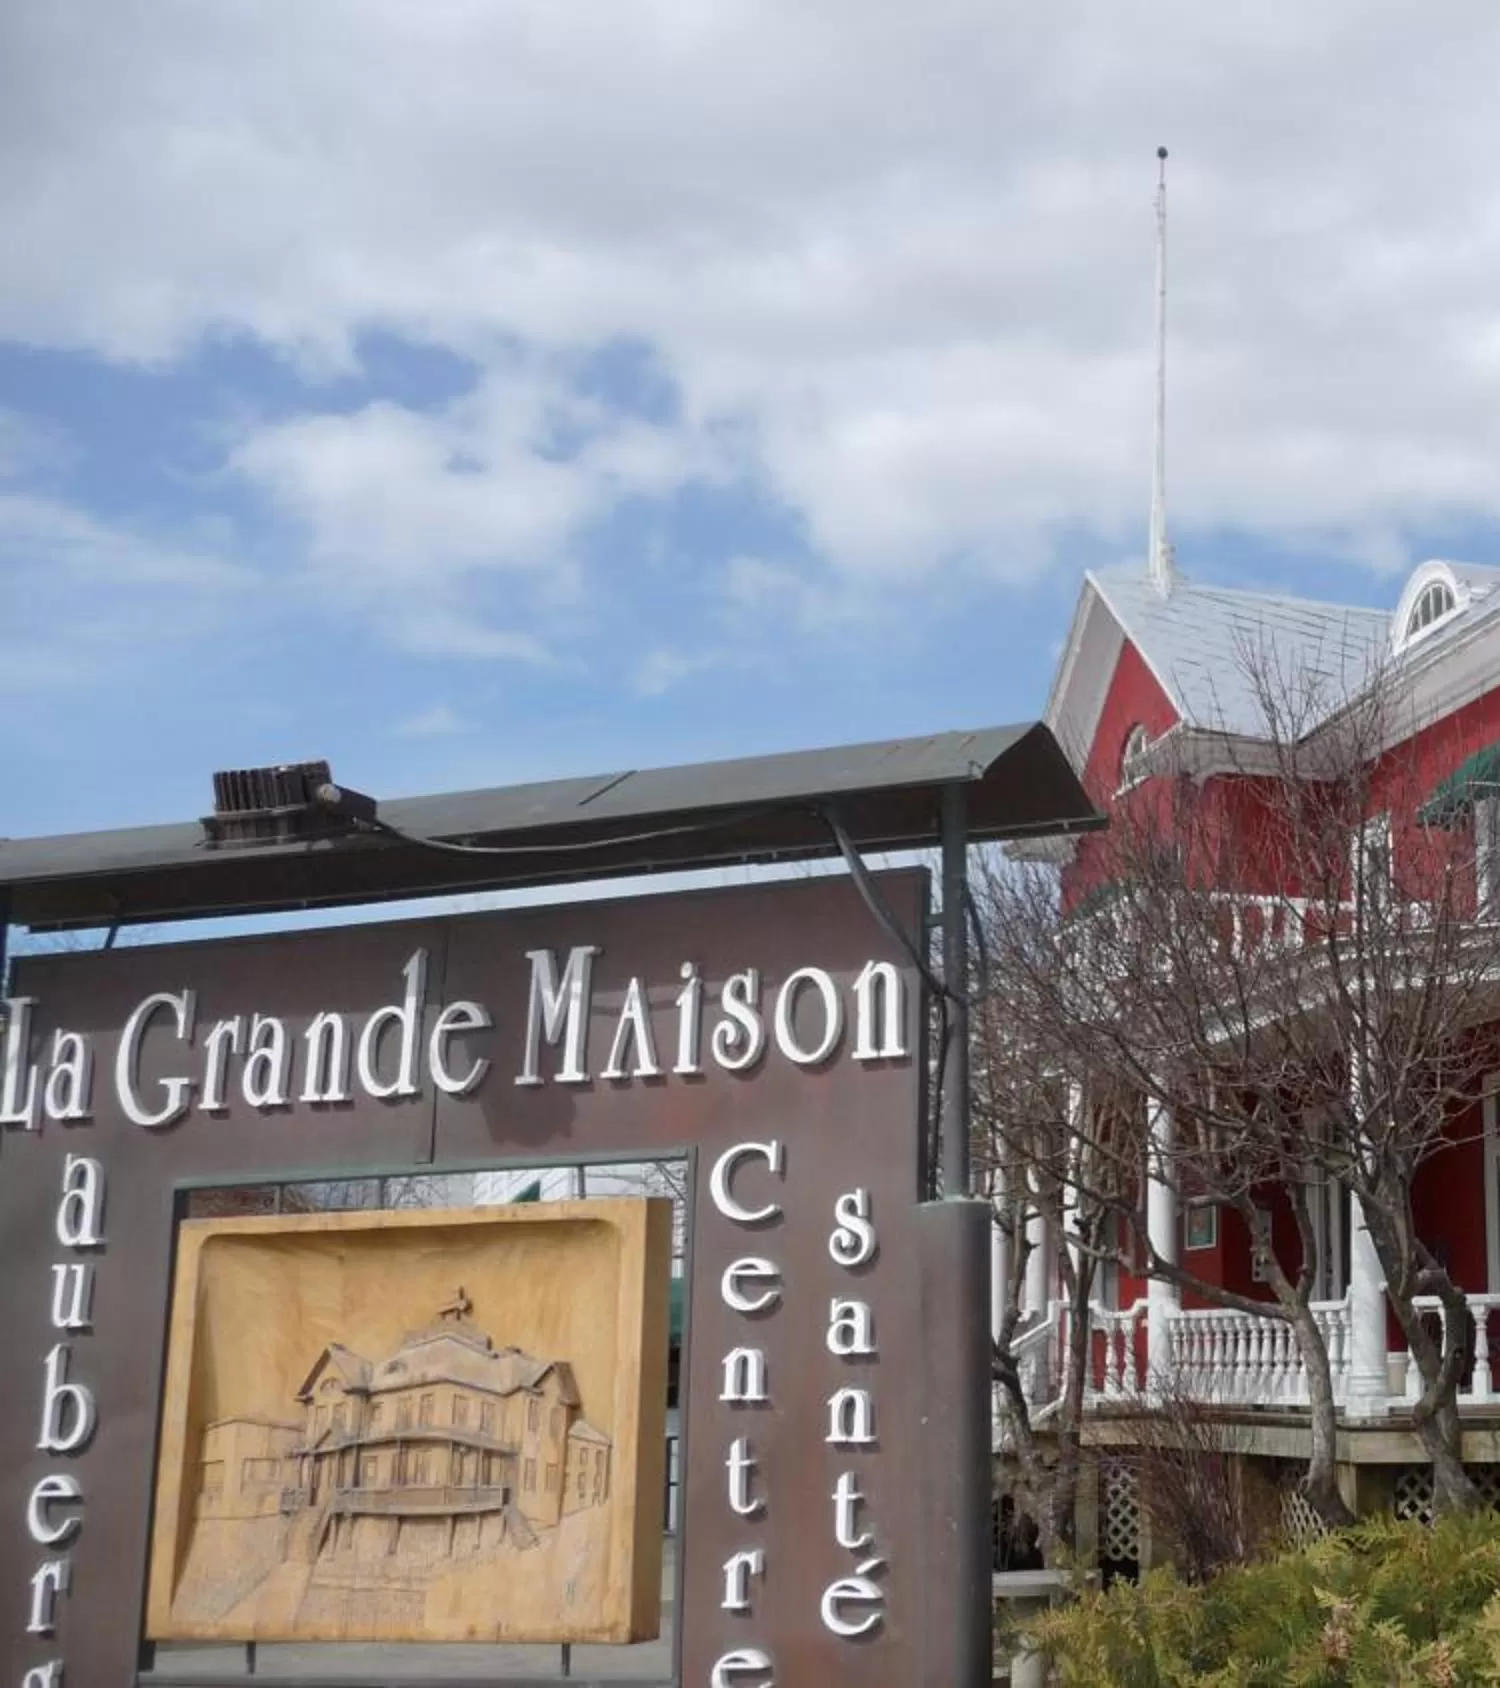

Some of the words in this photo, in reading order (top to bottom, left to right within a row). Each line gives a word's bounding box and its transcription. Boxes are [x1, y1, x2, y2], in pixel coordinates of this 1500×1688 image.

[0, 997, 93, 1129] La
[115, 947, 493, 1126] Grande
[709, 1138, 784, 1688] Centre
[821, 1187, 885, 1635] santé
